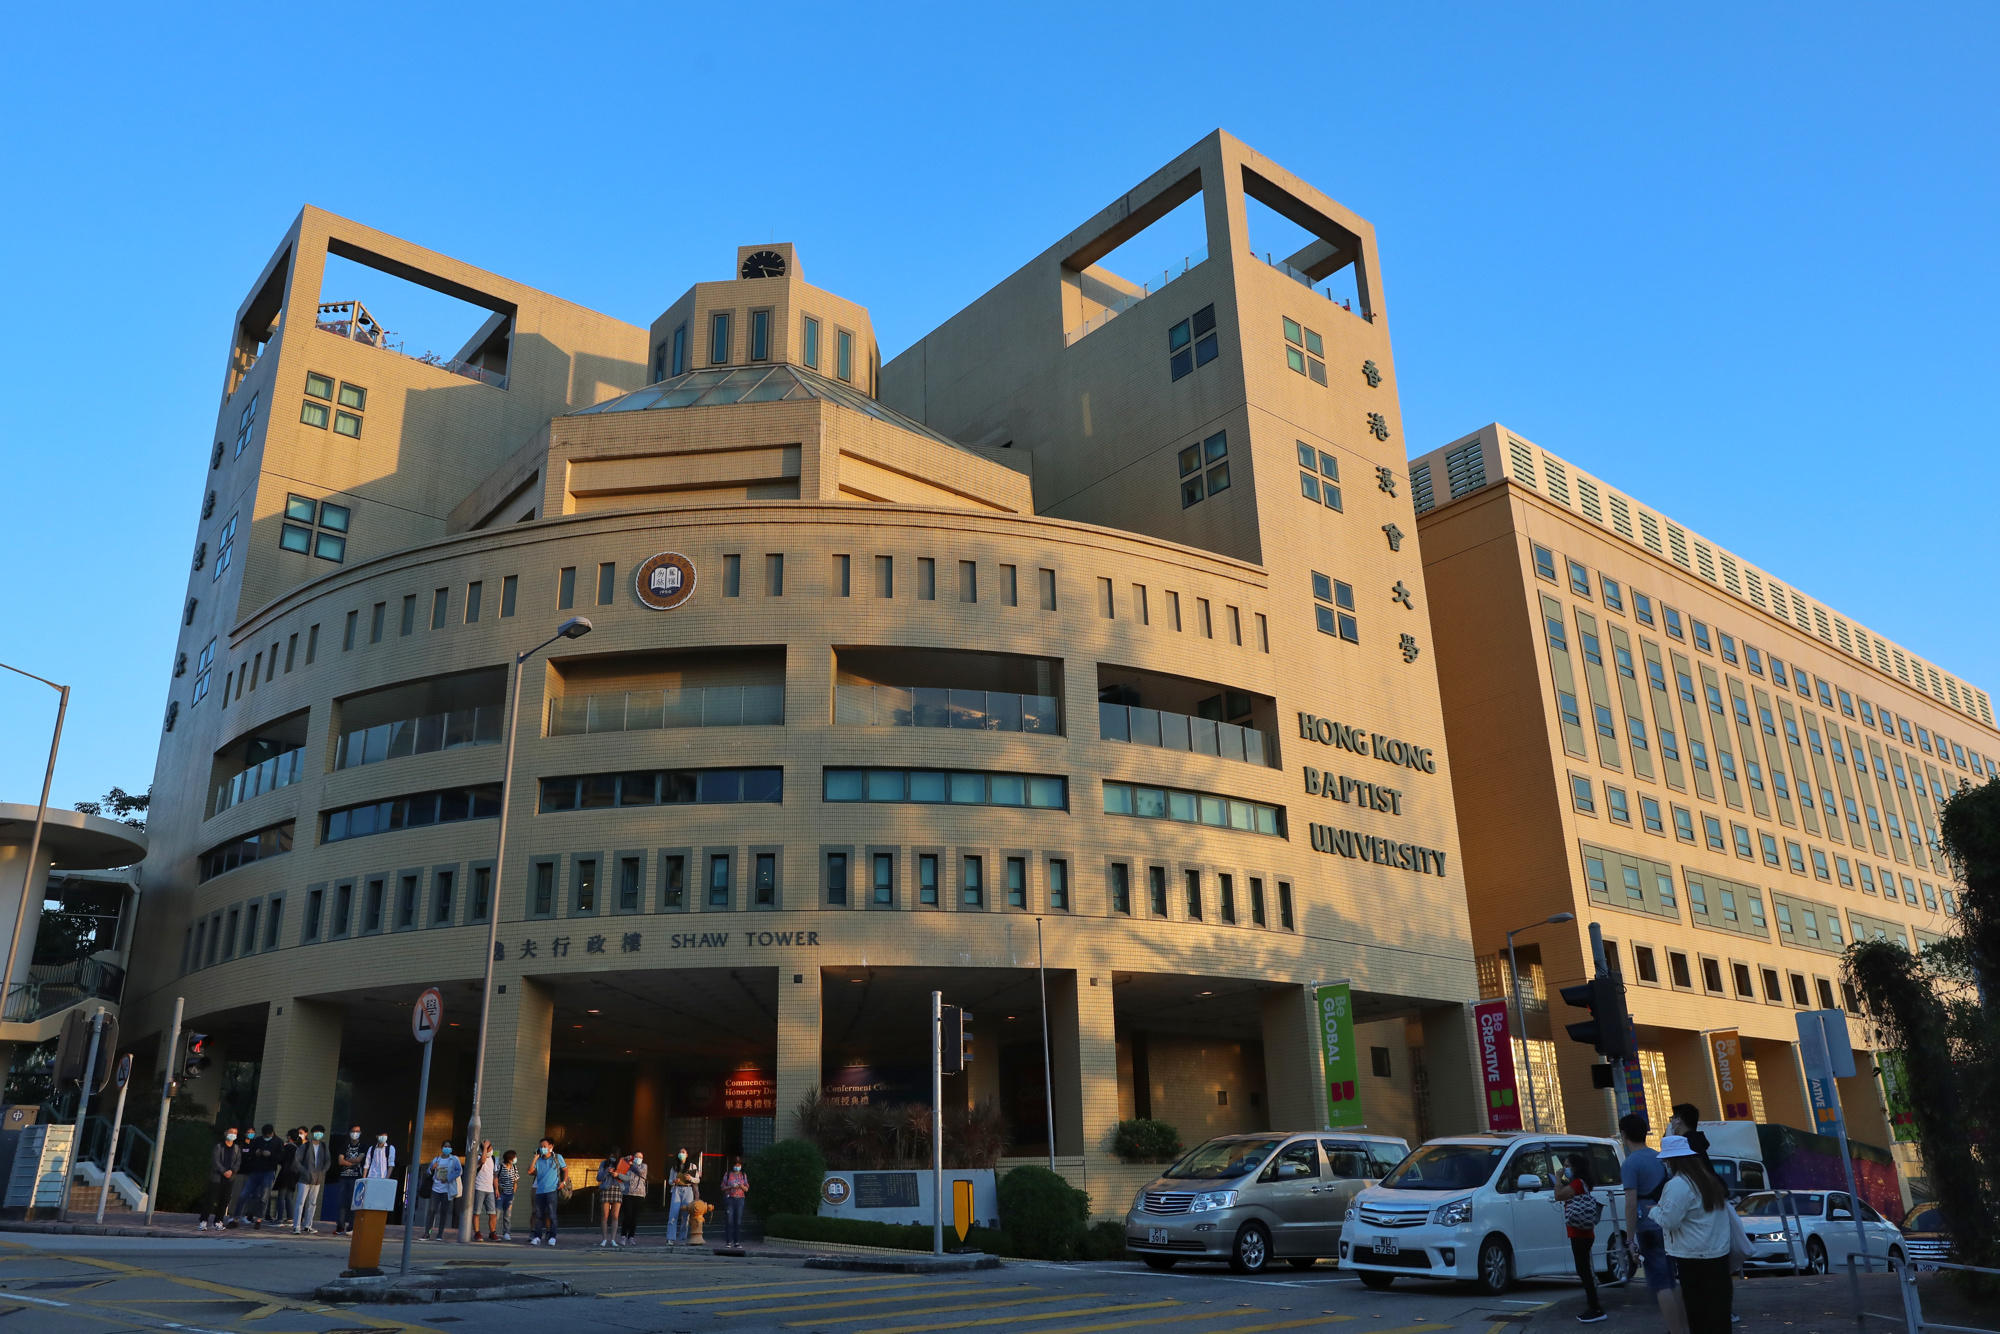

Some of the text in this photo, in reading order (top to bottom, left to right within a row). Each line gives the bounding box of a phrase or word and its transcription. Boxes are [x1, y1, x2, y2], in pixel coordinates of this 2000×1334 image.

[1362, 359, 1420, 664] 香港浸會大學
[1297, 711, 1437, 774] HONG KONG
[1303, 766, 1402, 815] BAPTIST
[1309, 822, 1446, 877] UNIVERSITY
[671, 931, 820, 949] SHAW TOWER
[1323, 997, 1340, 1065] GLOBAL
[1334, 995, 1347, 1018] Be
[1491, 1012, 1504, 1032] Be
[1481, 1013, 1501, 1082] CREATIVE
[1715, 1040, 1734, 1092] CARING
[725, 1088, 761, 1097] Honorary
